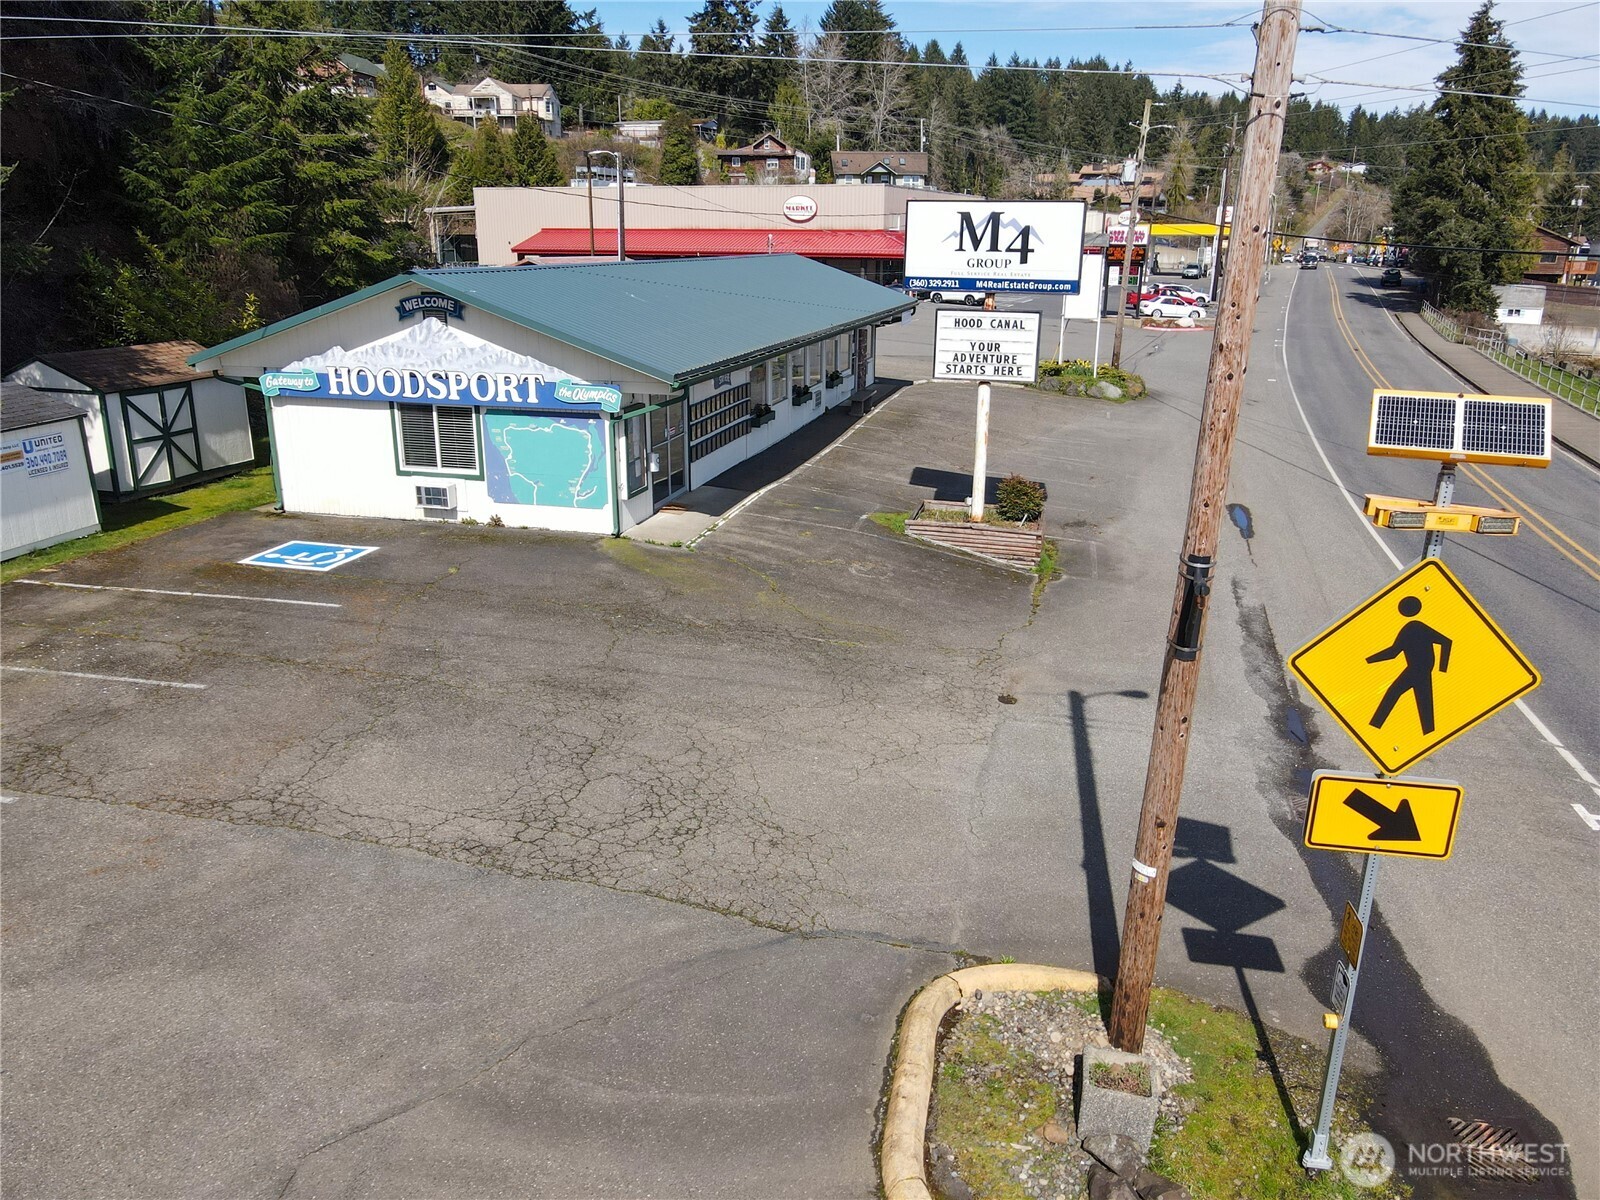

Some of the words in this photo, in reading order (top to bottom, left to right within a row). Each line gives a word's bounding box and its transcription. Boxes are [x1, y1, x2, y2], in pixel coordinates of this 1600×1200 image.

[955, 211, 1035, 264] M4
[967, 258, 1012, 269] GROUP
[909, 278, 928, 288] (360)
[928, 278, 960, 288] 329.2911
[975, 280, 1072, 291] M4RealEstateGroup.com
[402, 296, 455, 311] WELCOME
[954, 318, 983, 328] HOOD
[990, 319, 1025, 330] CANAL
[970, 342, 1001, 352] YOUR
[953, 353, 1017, 365] ADVENTURE
[945, 364, 986, 375] STARTS
[993, 366, 1022, 376] HERE
[265, 375, 303, 389] Gateway
[304, 376, 314, 386] to
[325, 366, 545, 404] HOODSPORT
[558, 386, 572, 398] the
[572, 387, 618, 403] Olympics
[34, 435, 63, 447] UNITED
[28, 466, 48, 476] LICENSED
